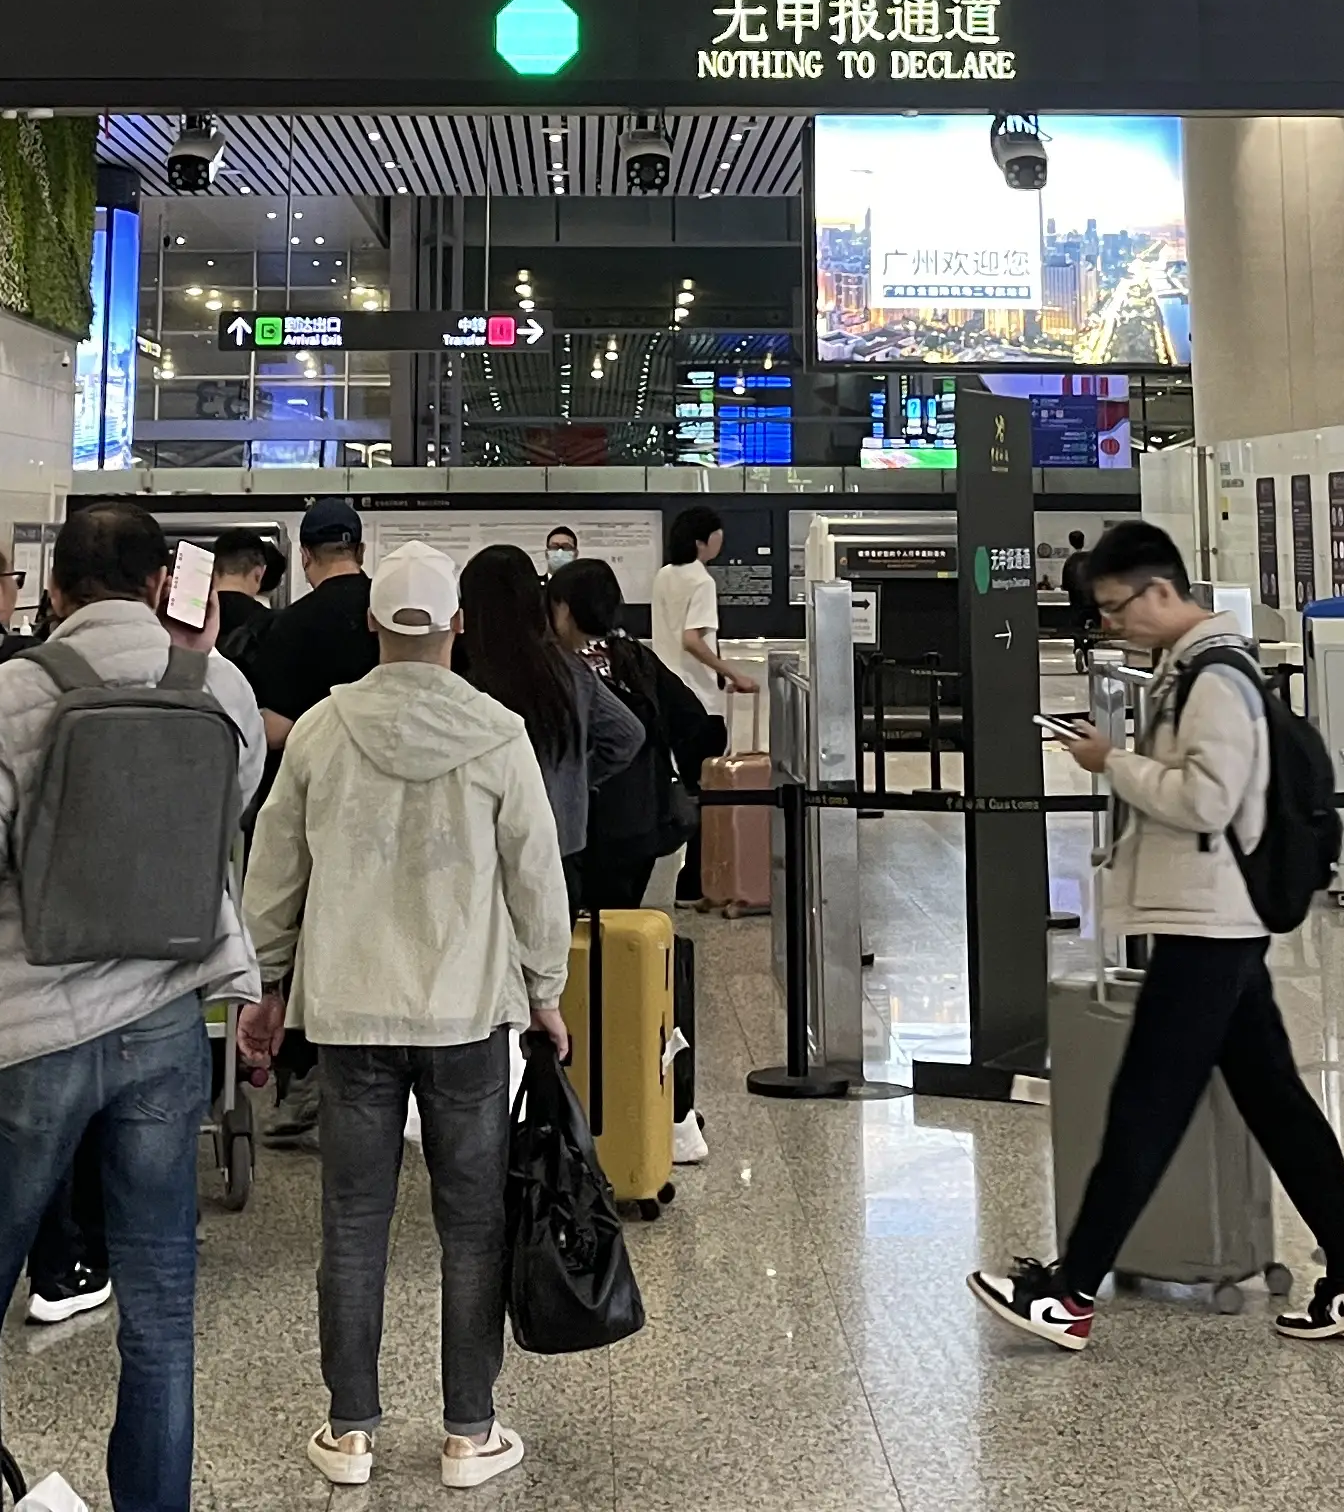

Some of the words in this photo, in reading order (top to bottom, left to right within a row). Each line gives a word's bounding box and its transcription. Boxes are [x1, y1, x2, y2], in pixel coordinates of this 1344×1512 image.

[697, 50, 824, 79] NOTHING
[837, 50, 876, 79] TO
[890, 50, 1017, 80] DECLARE
[882, 248, 1031, 277] 广州欢迎您
[283, 334, 320, 346] Arrival
[443, 333, 487, 346] Transfer
